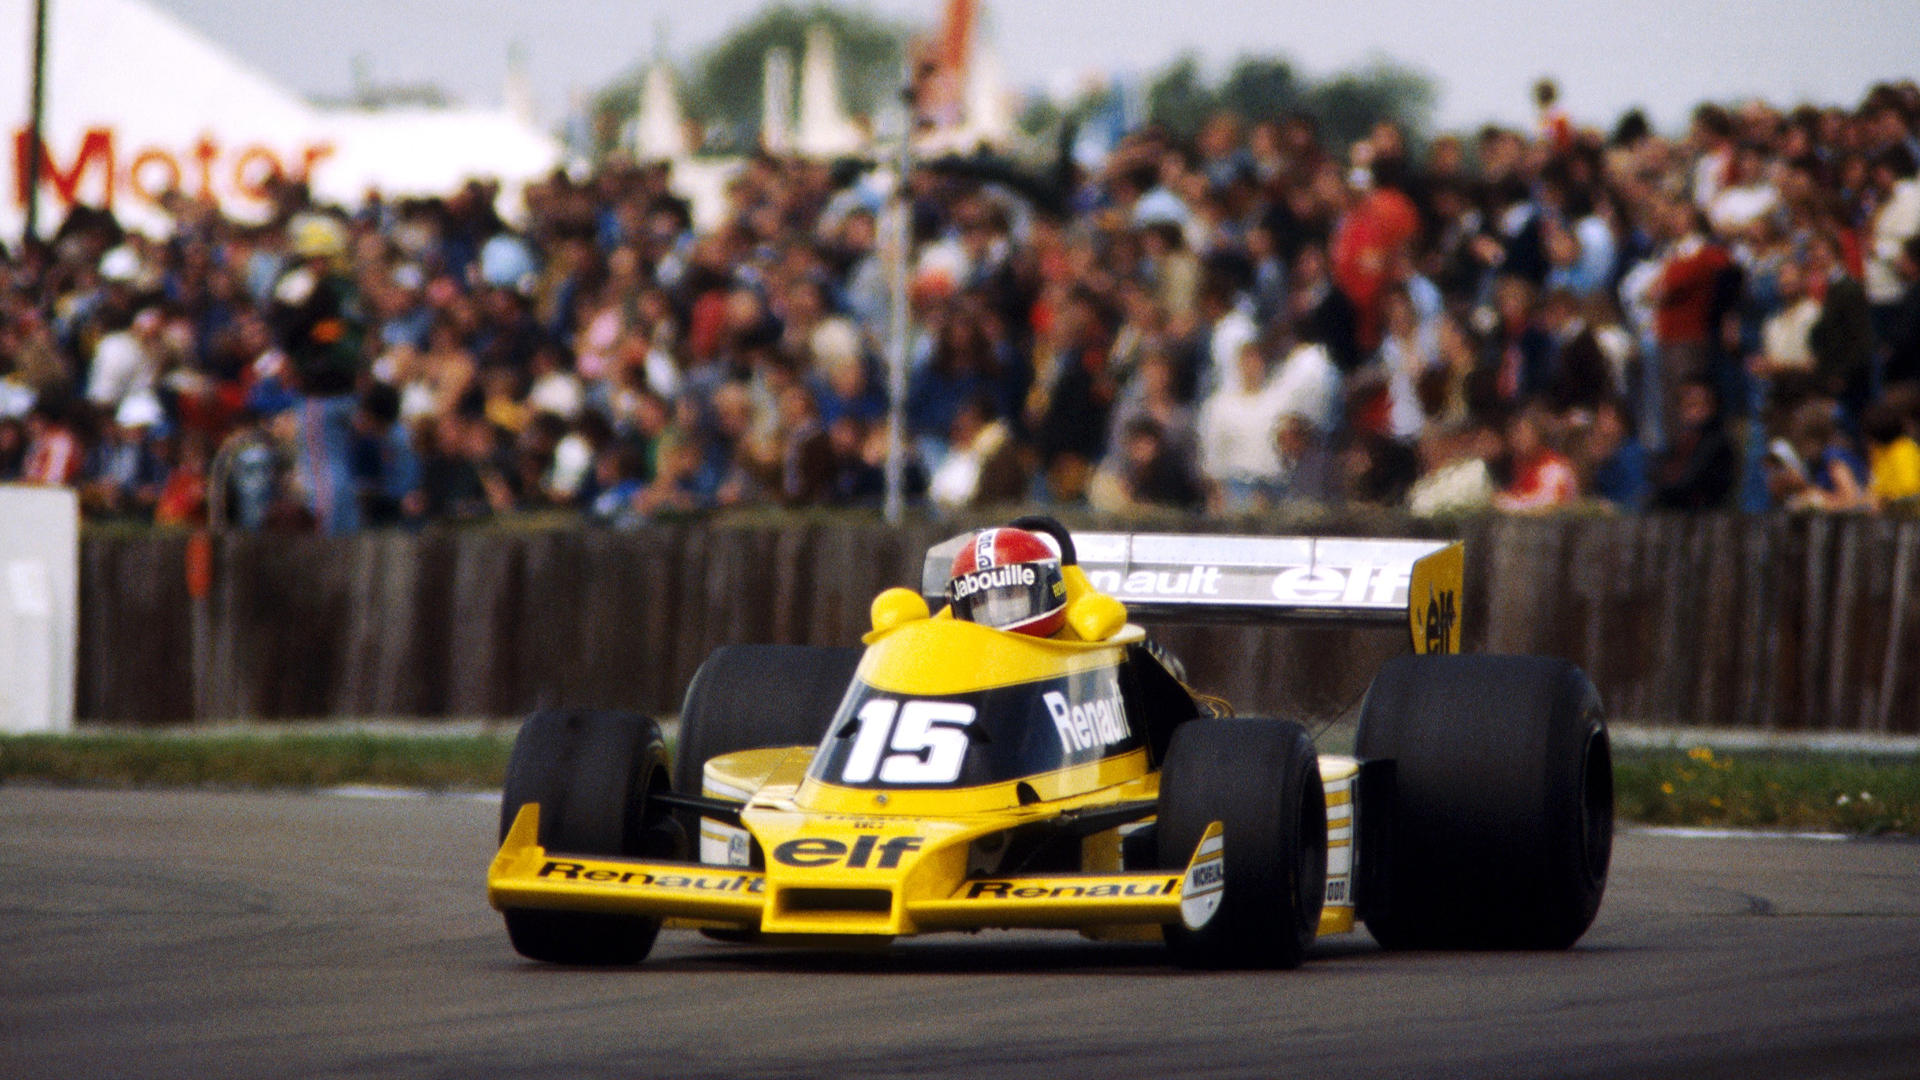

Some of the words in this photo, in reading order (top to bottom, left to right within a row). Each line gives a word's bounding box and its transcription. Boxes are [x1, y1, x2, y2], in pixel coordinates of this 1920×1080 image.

[14, 127, 335, 210] Motor
[954, 564, 1035, 601] Jabouille
[1091, 565, 1222, 595] nault
[1272, 561, 1409, 604] elf
[842, 699, 976, 783] 15
[773, 835, 925, 869] elf
[537, 861, 766, 893] Renault
[966, 878, 1184, 900] Renaul
